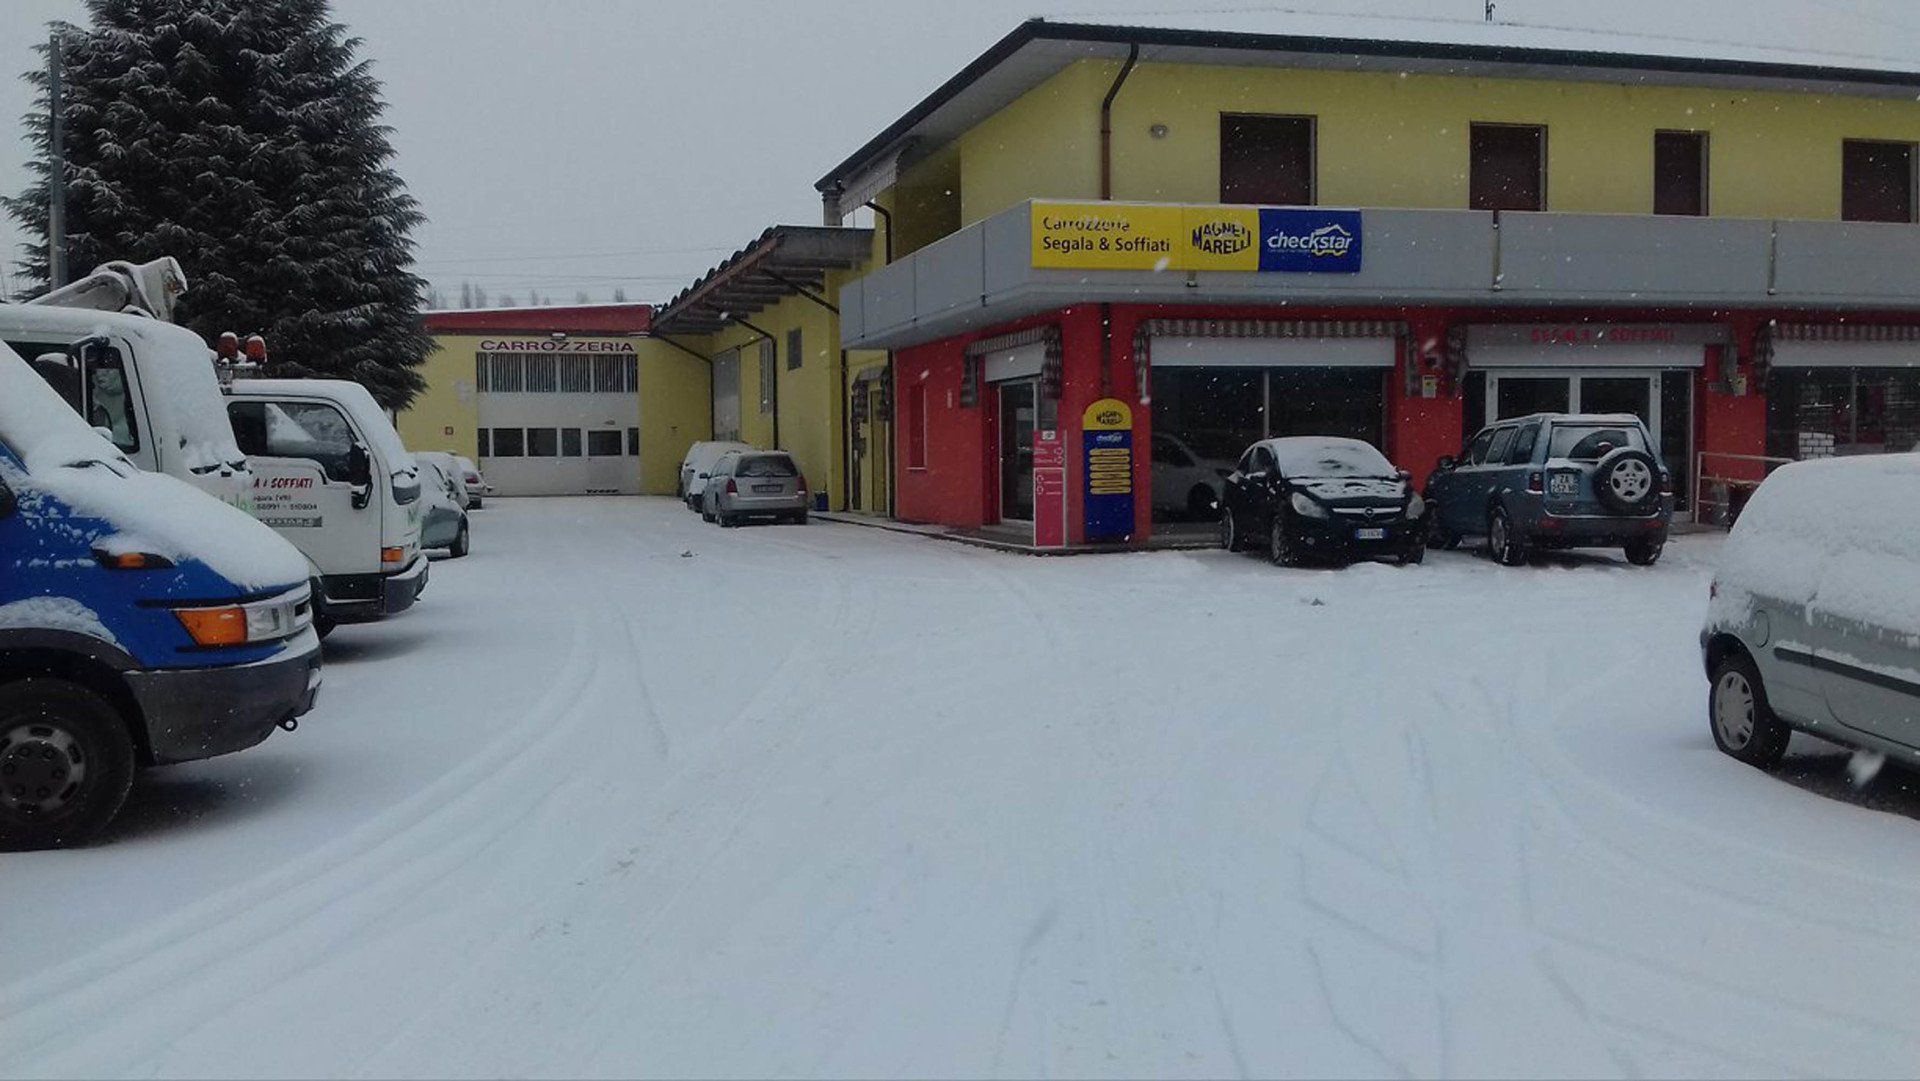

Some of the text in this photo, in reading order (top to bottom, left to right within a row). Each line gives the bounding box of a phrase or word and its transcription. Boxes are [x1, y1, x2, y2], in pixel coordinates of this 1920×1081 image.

[1043, 236, 1170, 253] Segala & Soffiati
[1267, 231, 1353, 249] checkstar
[480, 340, 634, 352] CARROZZERIA
